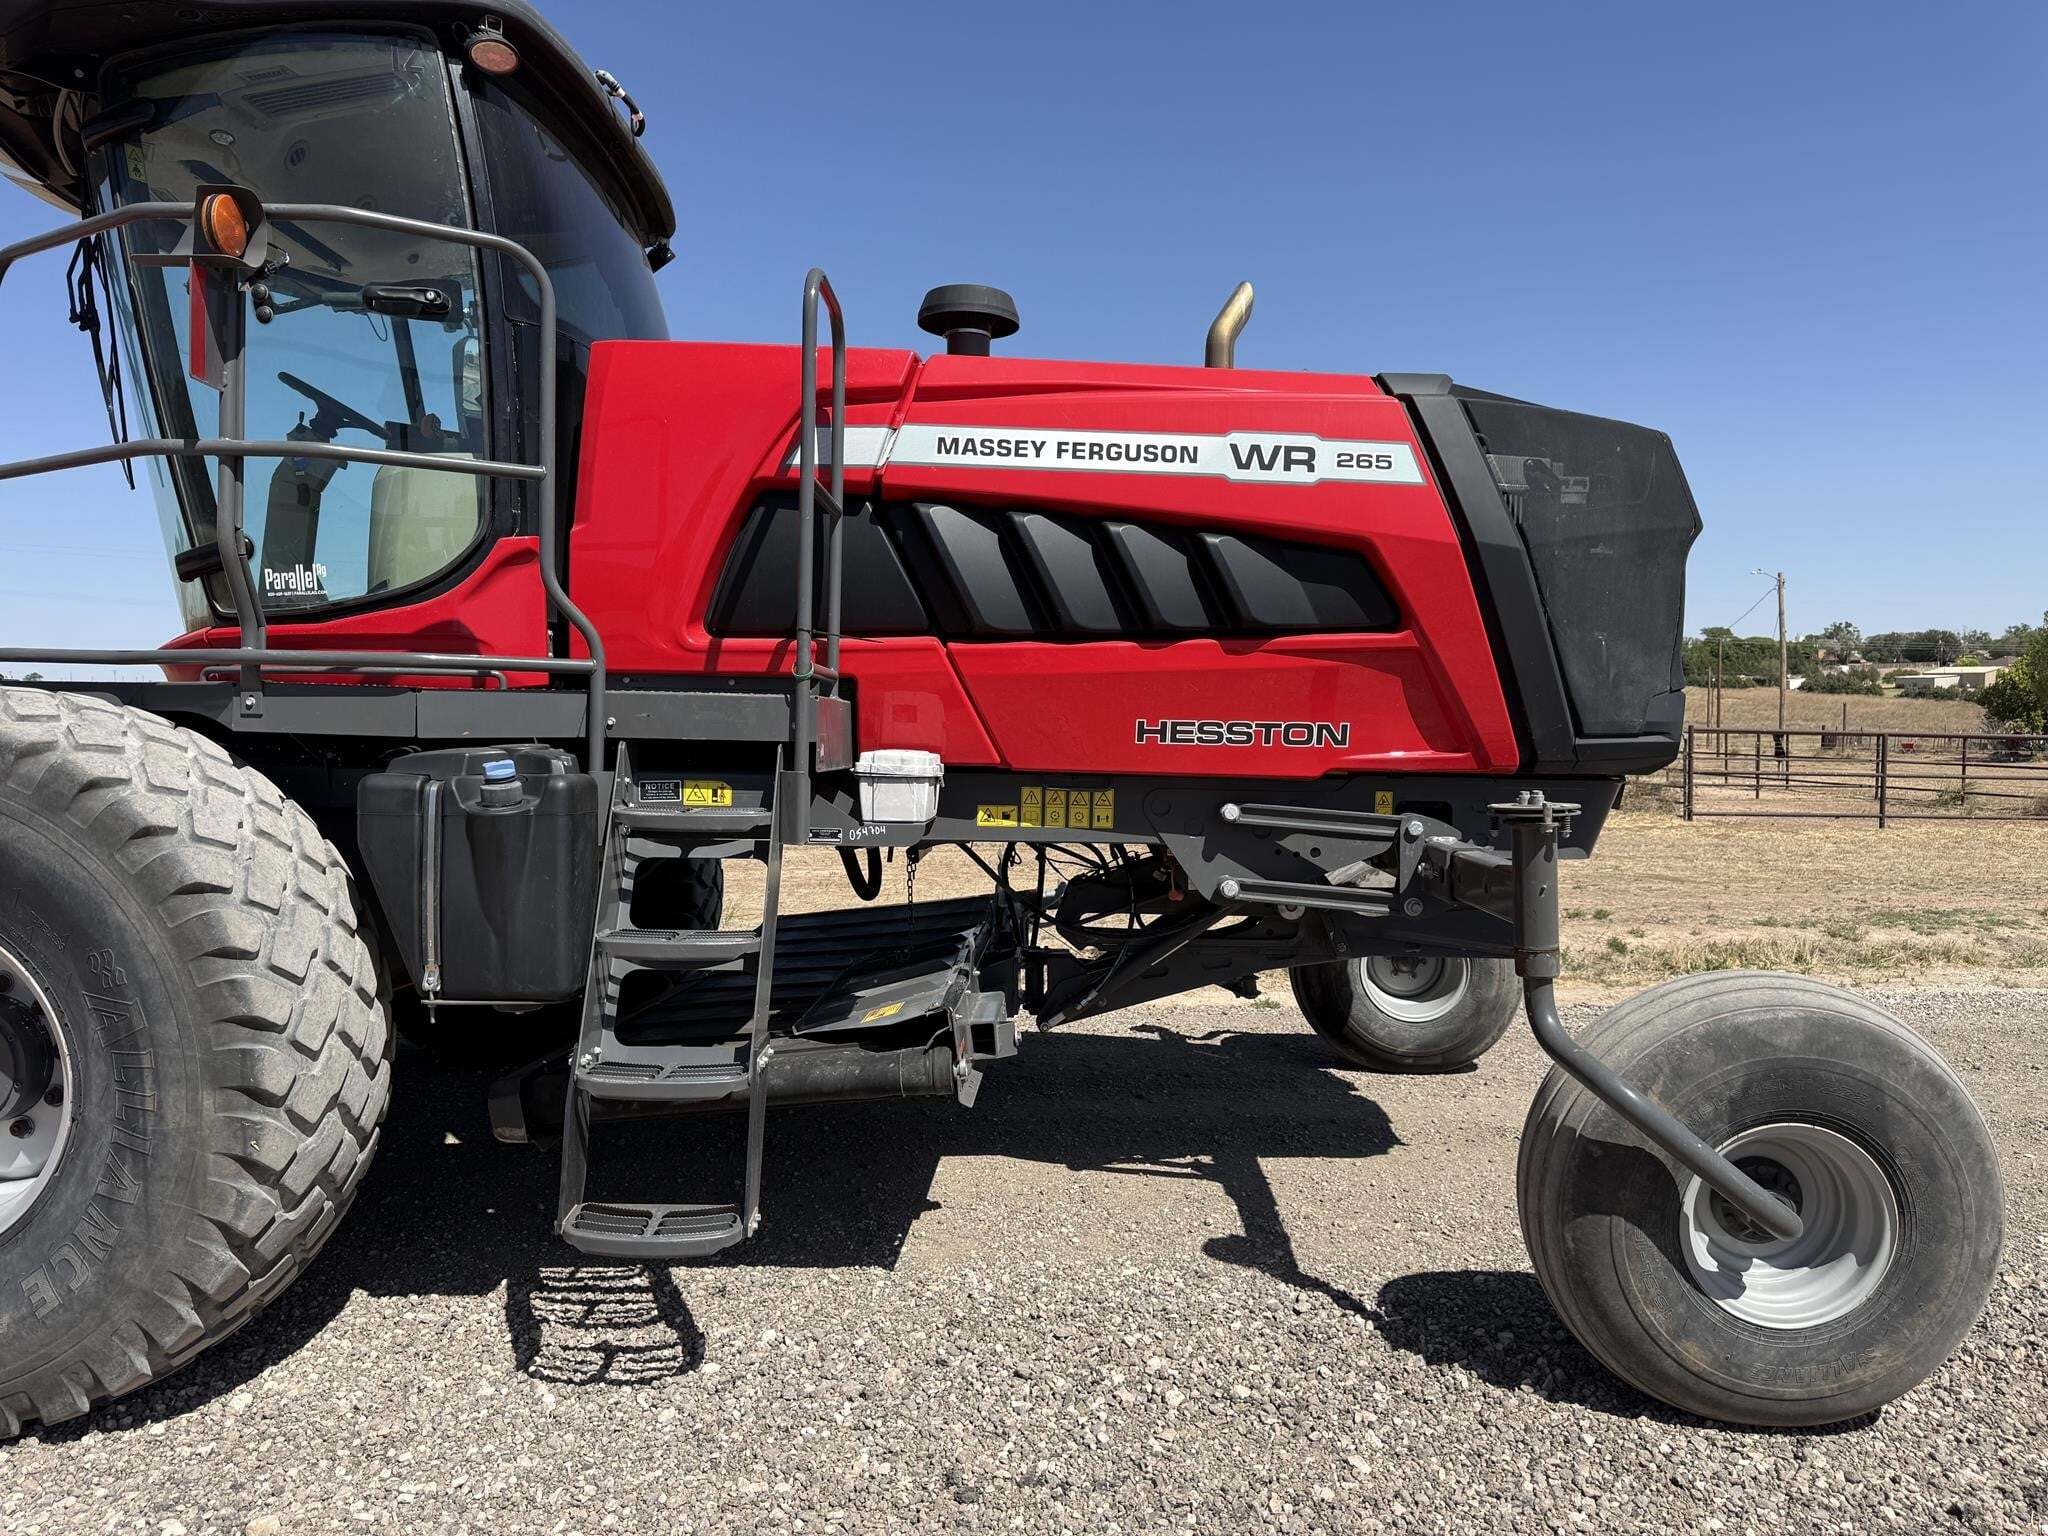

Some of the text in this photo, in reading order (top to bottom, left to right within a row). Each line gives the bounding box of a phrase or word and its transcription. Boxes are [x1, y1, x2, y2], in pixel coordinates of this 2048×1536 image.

[937, 437, 1198, 464] MASSEY FERGUSON
[1229, 443, 1392, 472] WR 265
[264, 564, 318, 590] Parallel
[1135, 719, 1350, 748] HESSTON
[19, 990, 158, 1320] ALLIANCE
